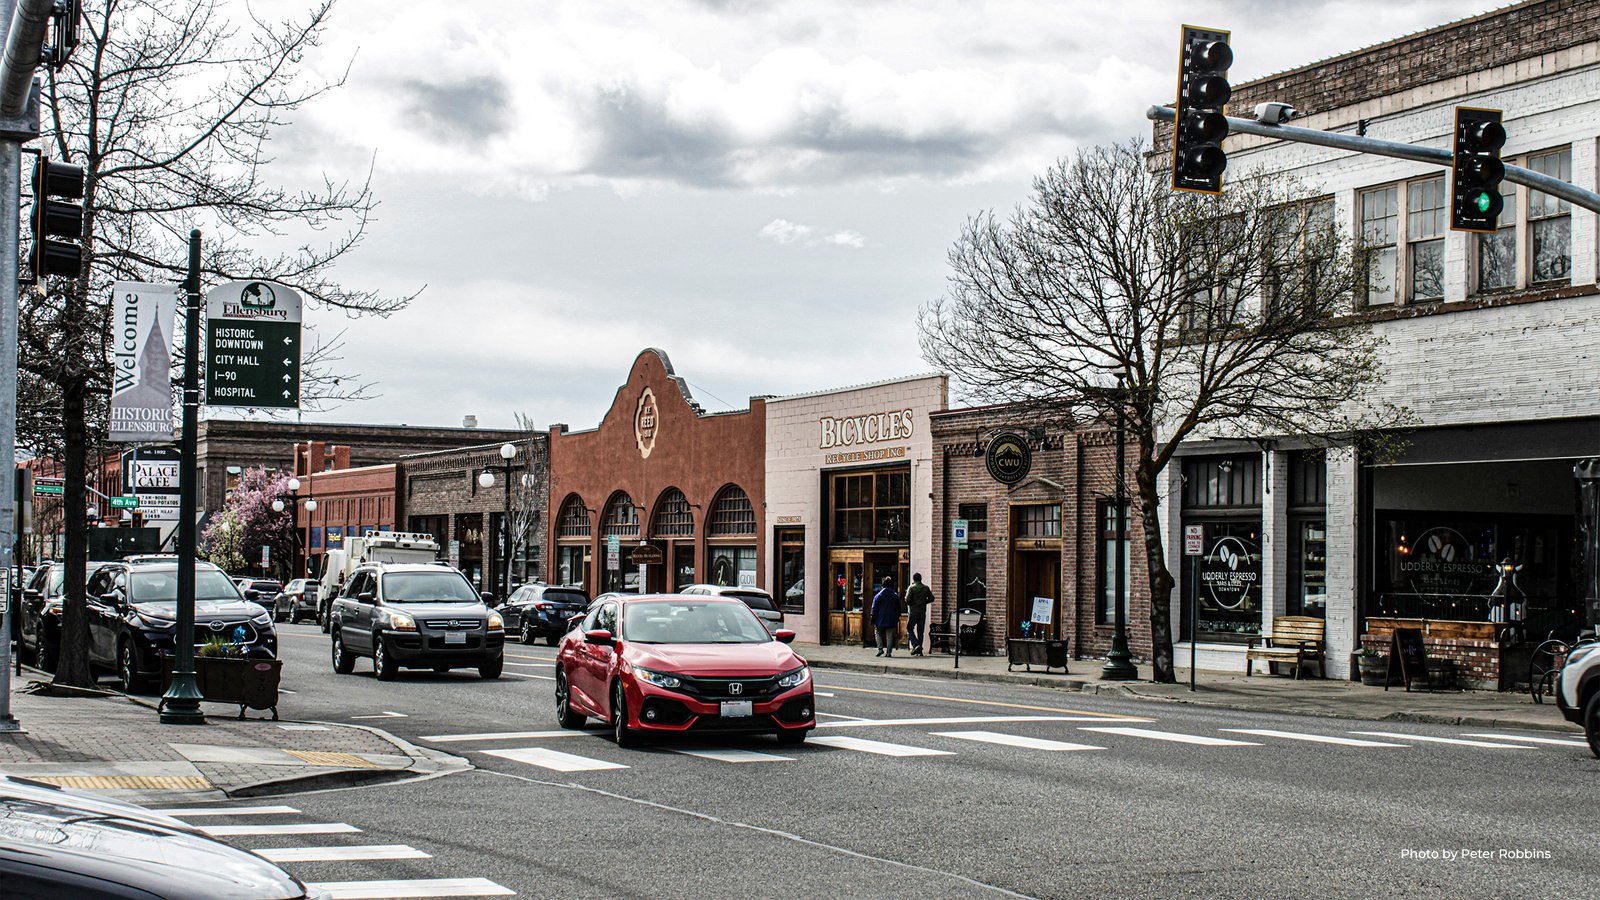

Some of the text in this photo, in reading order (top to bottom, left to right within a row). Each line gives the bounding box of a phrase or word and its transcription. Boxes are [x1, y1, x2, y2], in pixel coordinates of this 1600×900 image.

[223, 304, 287, 320] Ellensburg
[215, 328, 255, 338] HISTORIC
[114, 293, 139, 394] Welcome
[215, 339, 264, 350] DOWNTOWN
[215, 355, 260, 366] CITY HALL
[214, 387, 256, 398] HOSPITAL
[112, 407, 173, 421] HISTORIC
[111, 421, 173, 432] ELLENSBURG
[820, 408, 913, 449] BICYCLES
[863, 449, 884, 461] SHOP
[998, 458, 1020, 467] CWU
[131, 464, 178, 478] PALACE
[138, 477, 170, 487] CAFE
[1400, 561, 1483, 573] UDDERLY ESPRESSO
[1202, 572, 1257, 581] UDDERLY ESPRESSO
